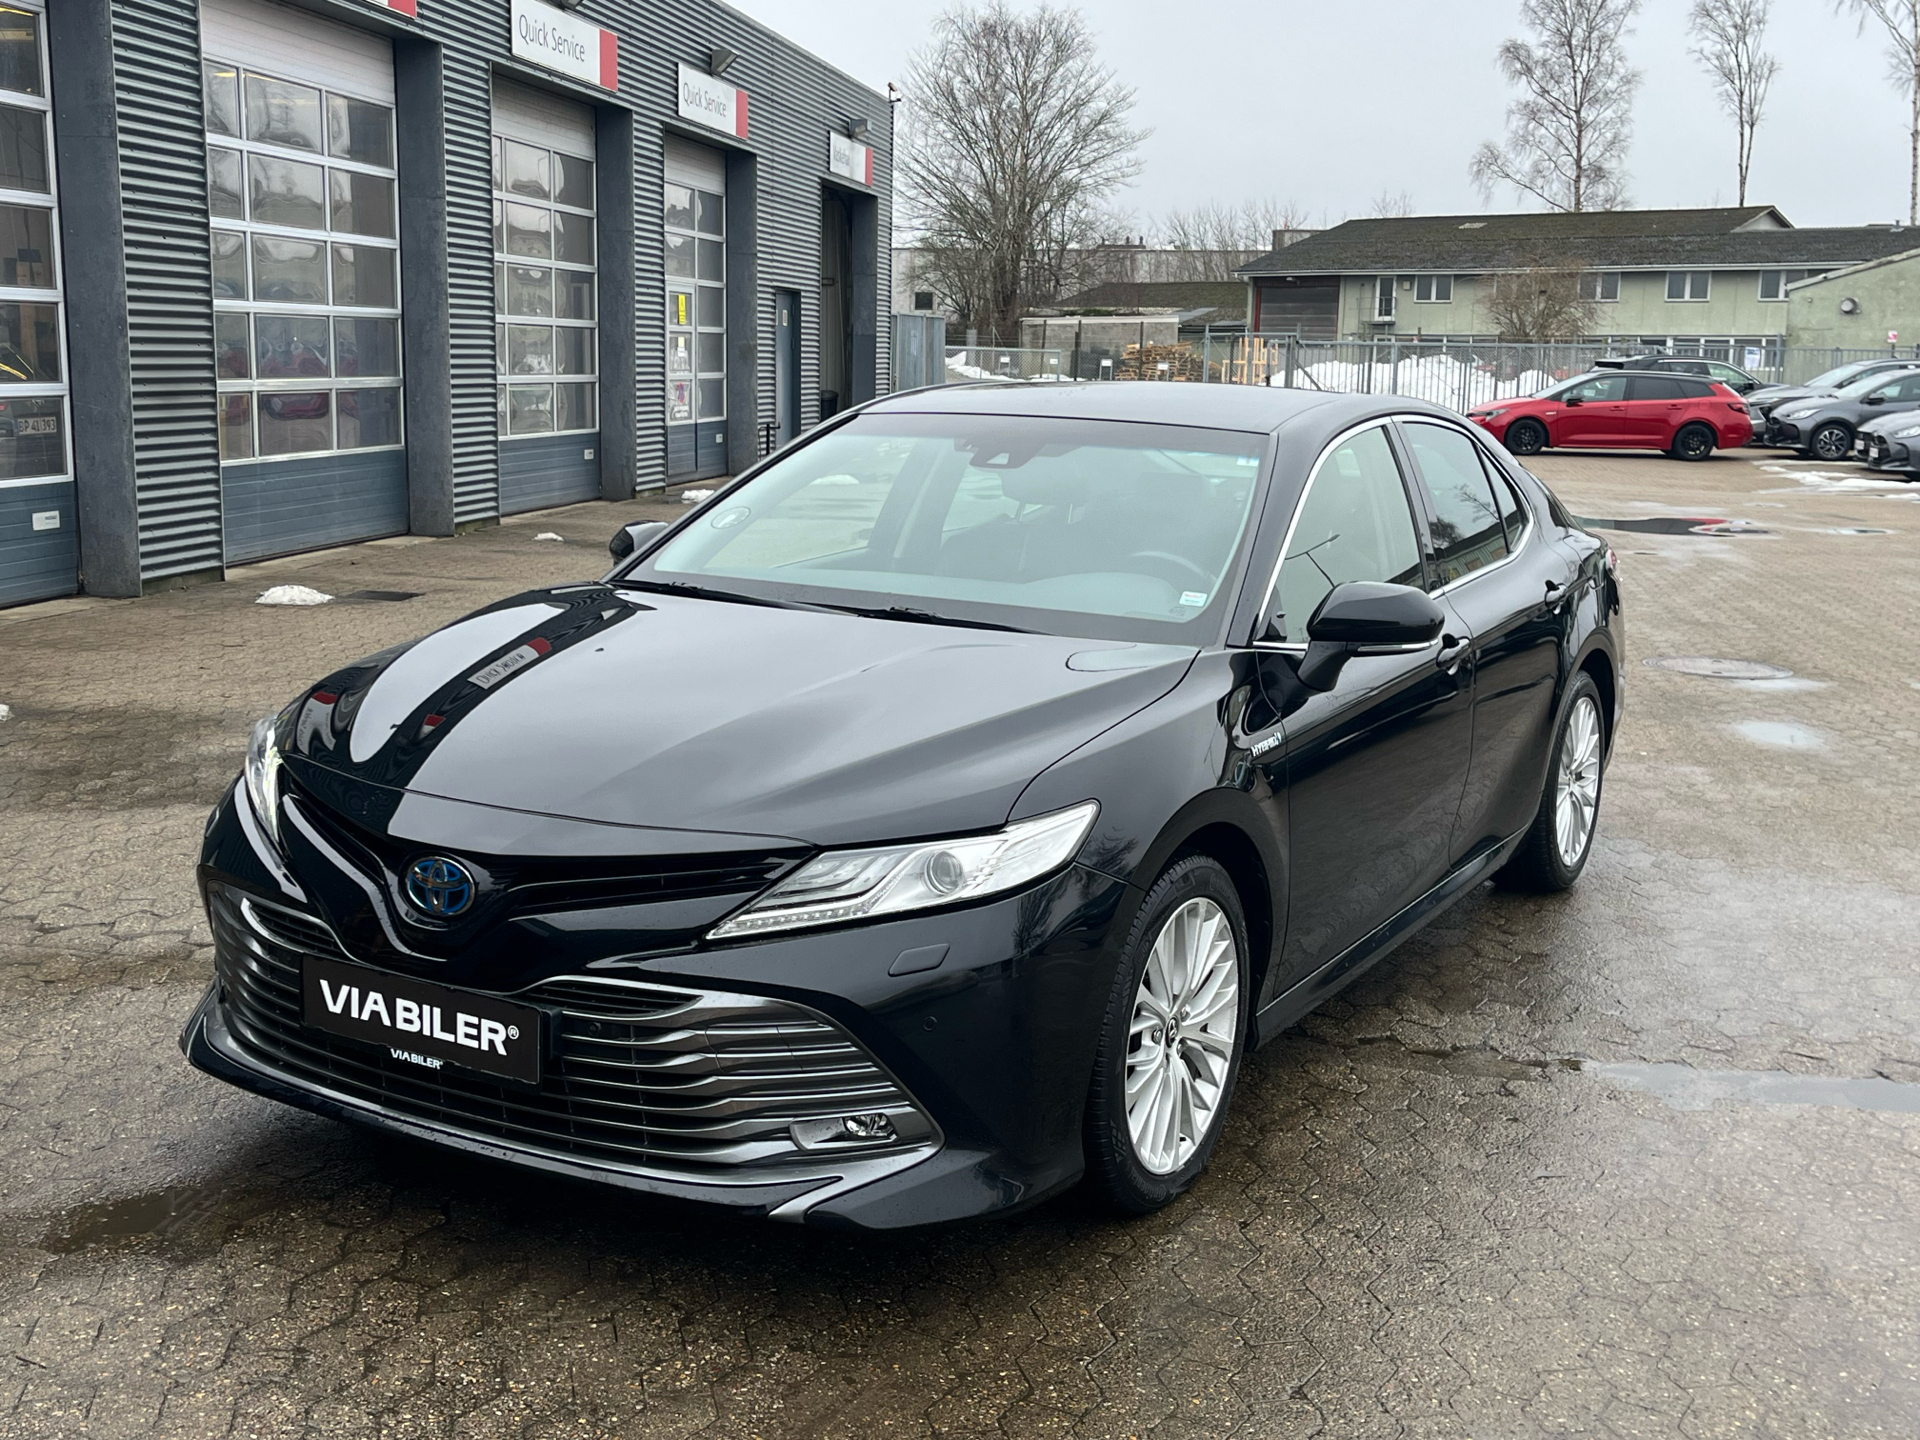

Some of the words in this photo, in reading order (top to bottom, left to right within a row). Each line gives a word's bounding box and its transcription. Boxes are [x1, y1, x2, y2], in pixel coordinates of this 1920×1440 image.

[518, 14, 549, 48] Quick
[551, 27, 586, 63] Service
[682, 82, 703, 108] Quick
[704, 90, 727, 118] Service
[41, 418, 56, 431] 393
[319, 979, 392, 1028] VIA
[390, 1048, 411, 1062] VIA
